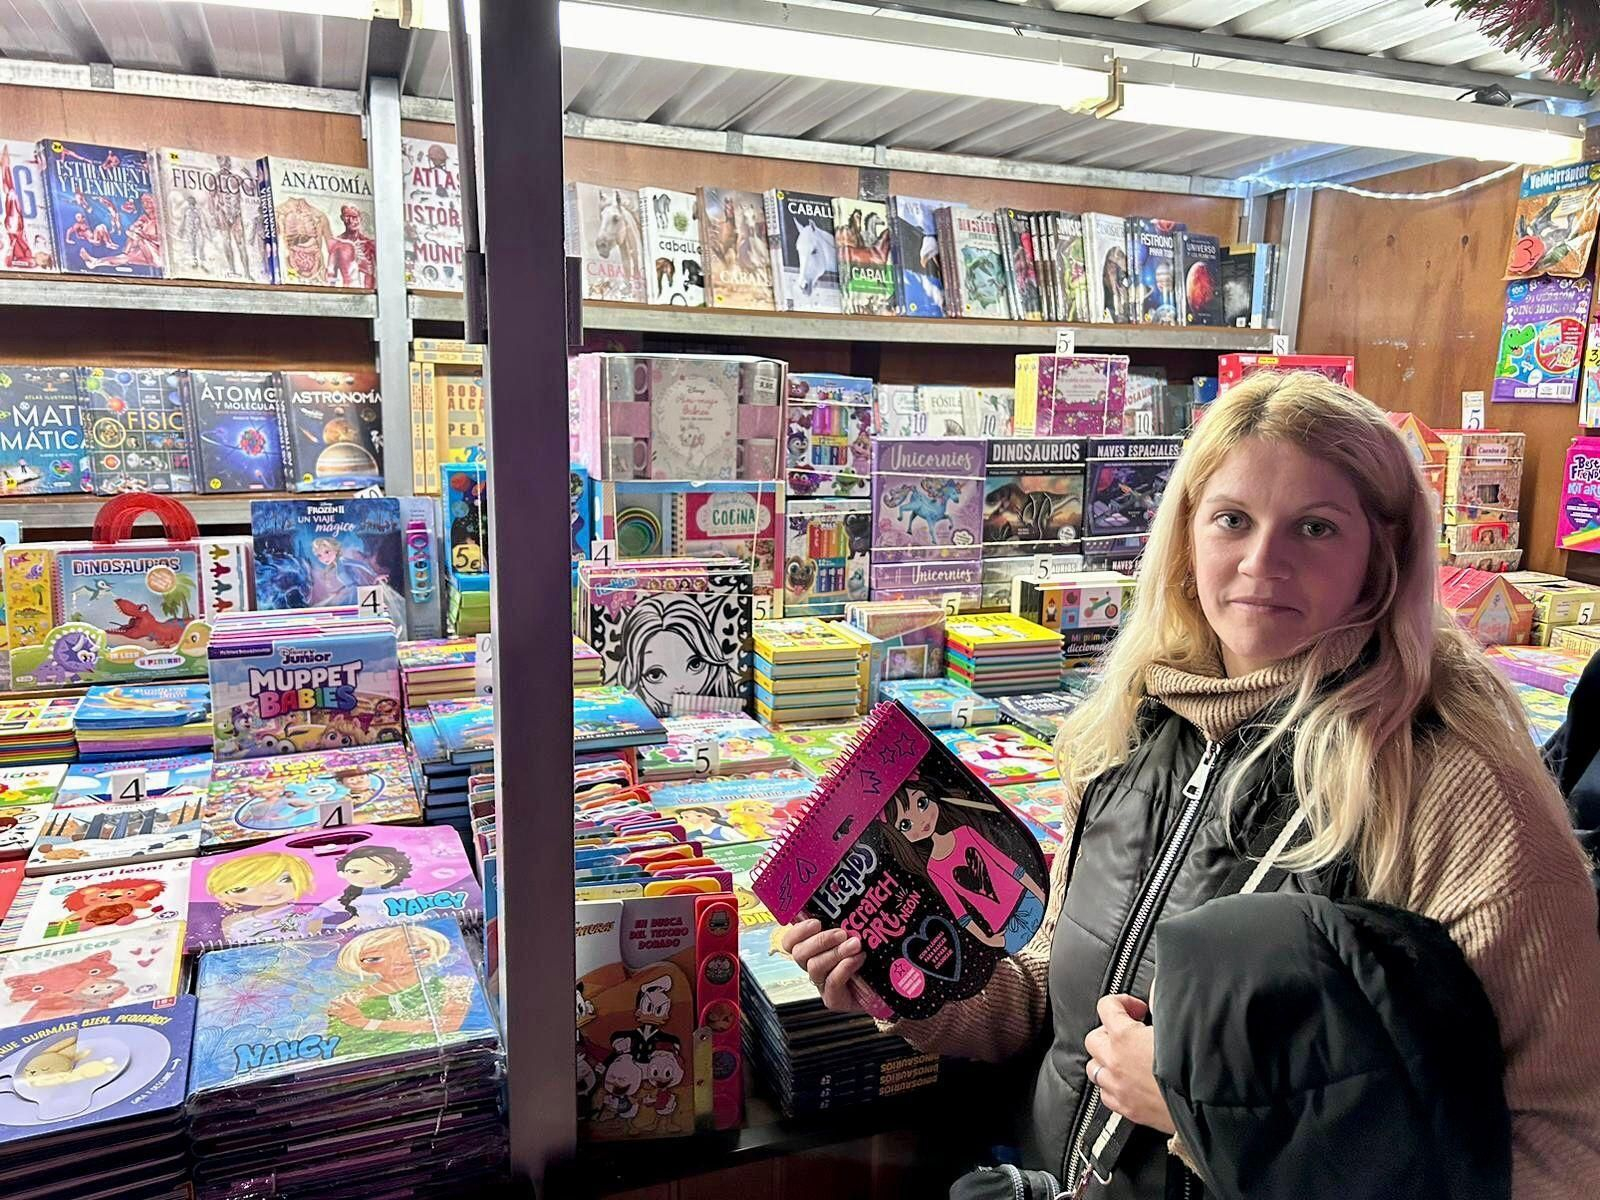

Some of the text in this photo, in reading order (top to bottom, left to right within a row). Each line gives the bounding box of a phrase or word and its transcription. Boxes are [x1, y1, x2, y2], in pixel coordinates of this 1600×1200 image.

[281, 170, 372, 196] ANATOMÍA
[1058, 333, 1070, 353] 5
[1276, 337, 1285, 355] 8
[292, 389, 382, 404] ASTRONOMÍA
[913, 413, 927, 435] 10
[983, 415, 996, 436] 10
[1138, 414, 1150, 434] 10
[1466, 409, 1481, 430] 5
[891, 443, 974, 471] Unicornios
[992, 441, 1081, 463] DINOSAURIOS
[1097, 443, 1180, 458] NAVES ESPACIALES
[298, 514, 335, 524] UN VIAJE
[307, 506, 338, 515] FROZEN
[594, 544, 611, 567] 4
[1112, 560, 1133, 571] NAVES
[912, 564, 973, 585] Unicornios
[1037, 559, 1051, 580] 5
[363, 589, 381, 614] 4
[753, 600, 767, 620] 5
[945, 598, 957, 616] 5
[1578, 607, 1591, 625] 5
[249, 659, 363, 697] MUPPET
[258, 685, 357, 720] BABIES
[956, 708, 968, 728] 5
[695, 747, 710, 774] 5
[119, 778, 145, 802] 4
[322, 805, 348, 830] 4
[98, 869, 114, 877] el
[383, 891, 469, 918] NANCY
[899, 890, 921, 923] NEON
[635, 917, 683, 929] EN BUSCA
[629, 928, 689, 940] DEL TESORO
[638, 939, 681, 950] DORADO
[22, 938, 121, 962] Mimitos
[234, 1034, 342, 1073] NANCY
